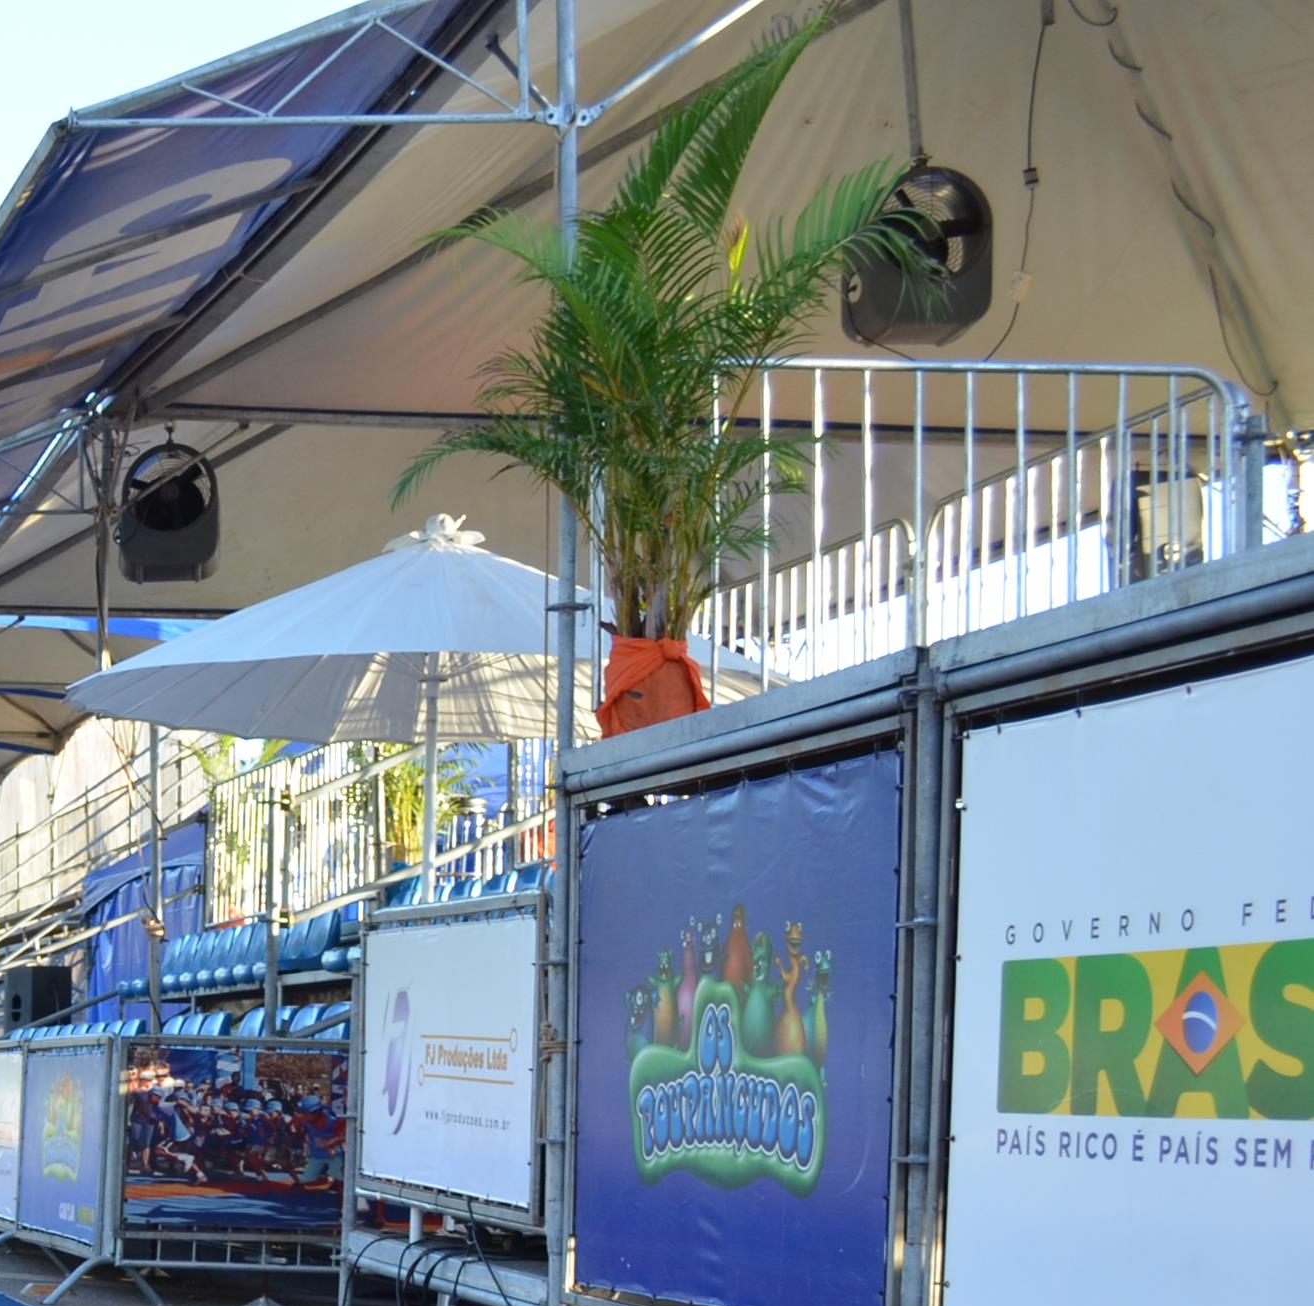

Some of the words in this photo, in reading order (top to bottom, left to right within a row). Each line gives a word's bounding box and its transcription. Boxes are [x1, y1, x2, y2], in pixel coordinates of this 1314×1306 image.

[1005, 908, 1195, 945] GOVERNO
[1242, 895, 1314, 927] FE
[425, 1043, 436, 1065] FJ
[437, 1043, 484, 1073] Produções
[487, 1047, 508, 1071] Ltda
[699, 1003, 734, 1076] OS
[996, 1125, 1046, 1158] PAÍS
[1058, 1132, 1118, 1161] RICO
[1132, 1129, 1146, 1163] É
[1159, 1130, 1219, 1166] PAÍS
[1234, 1137, 1292, 1169] SEM
